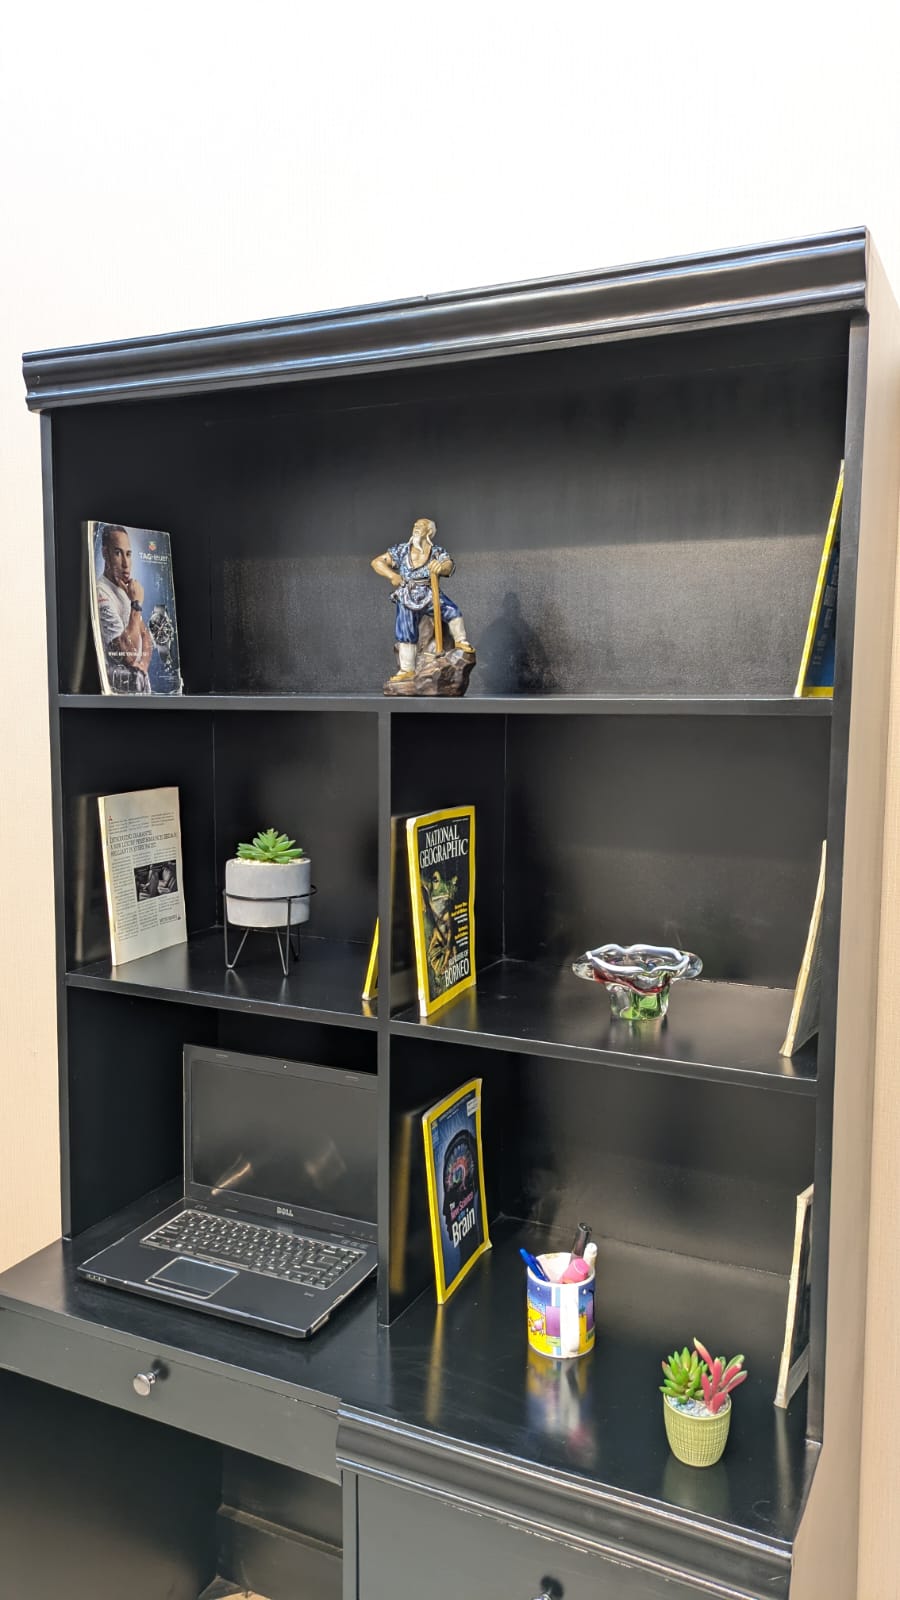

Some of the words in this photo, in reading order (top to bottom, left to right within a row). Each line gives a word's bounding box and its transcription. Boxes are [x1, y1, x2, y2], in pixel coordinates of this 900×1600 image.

[425, 824, 460, 849] NATIONAL
[419, 838, 469, 869] GEOGRAPHIC
[444, 958, 470, 987] BORNEO
[276, 1206, 294, 1217] DELL
[452, 1207, 476, 1249] Brain
